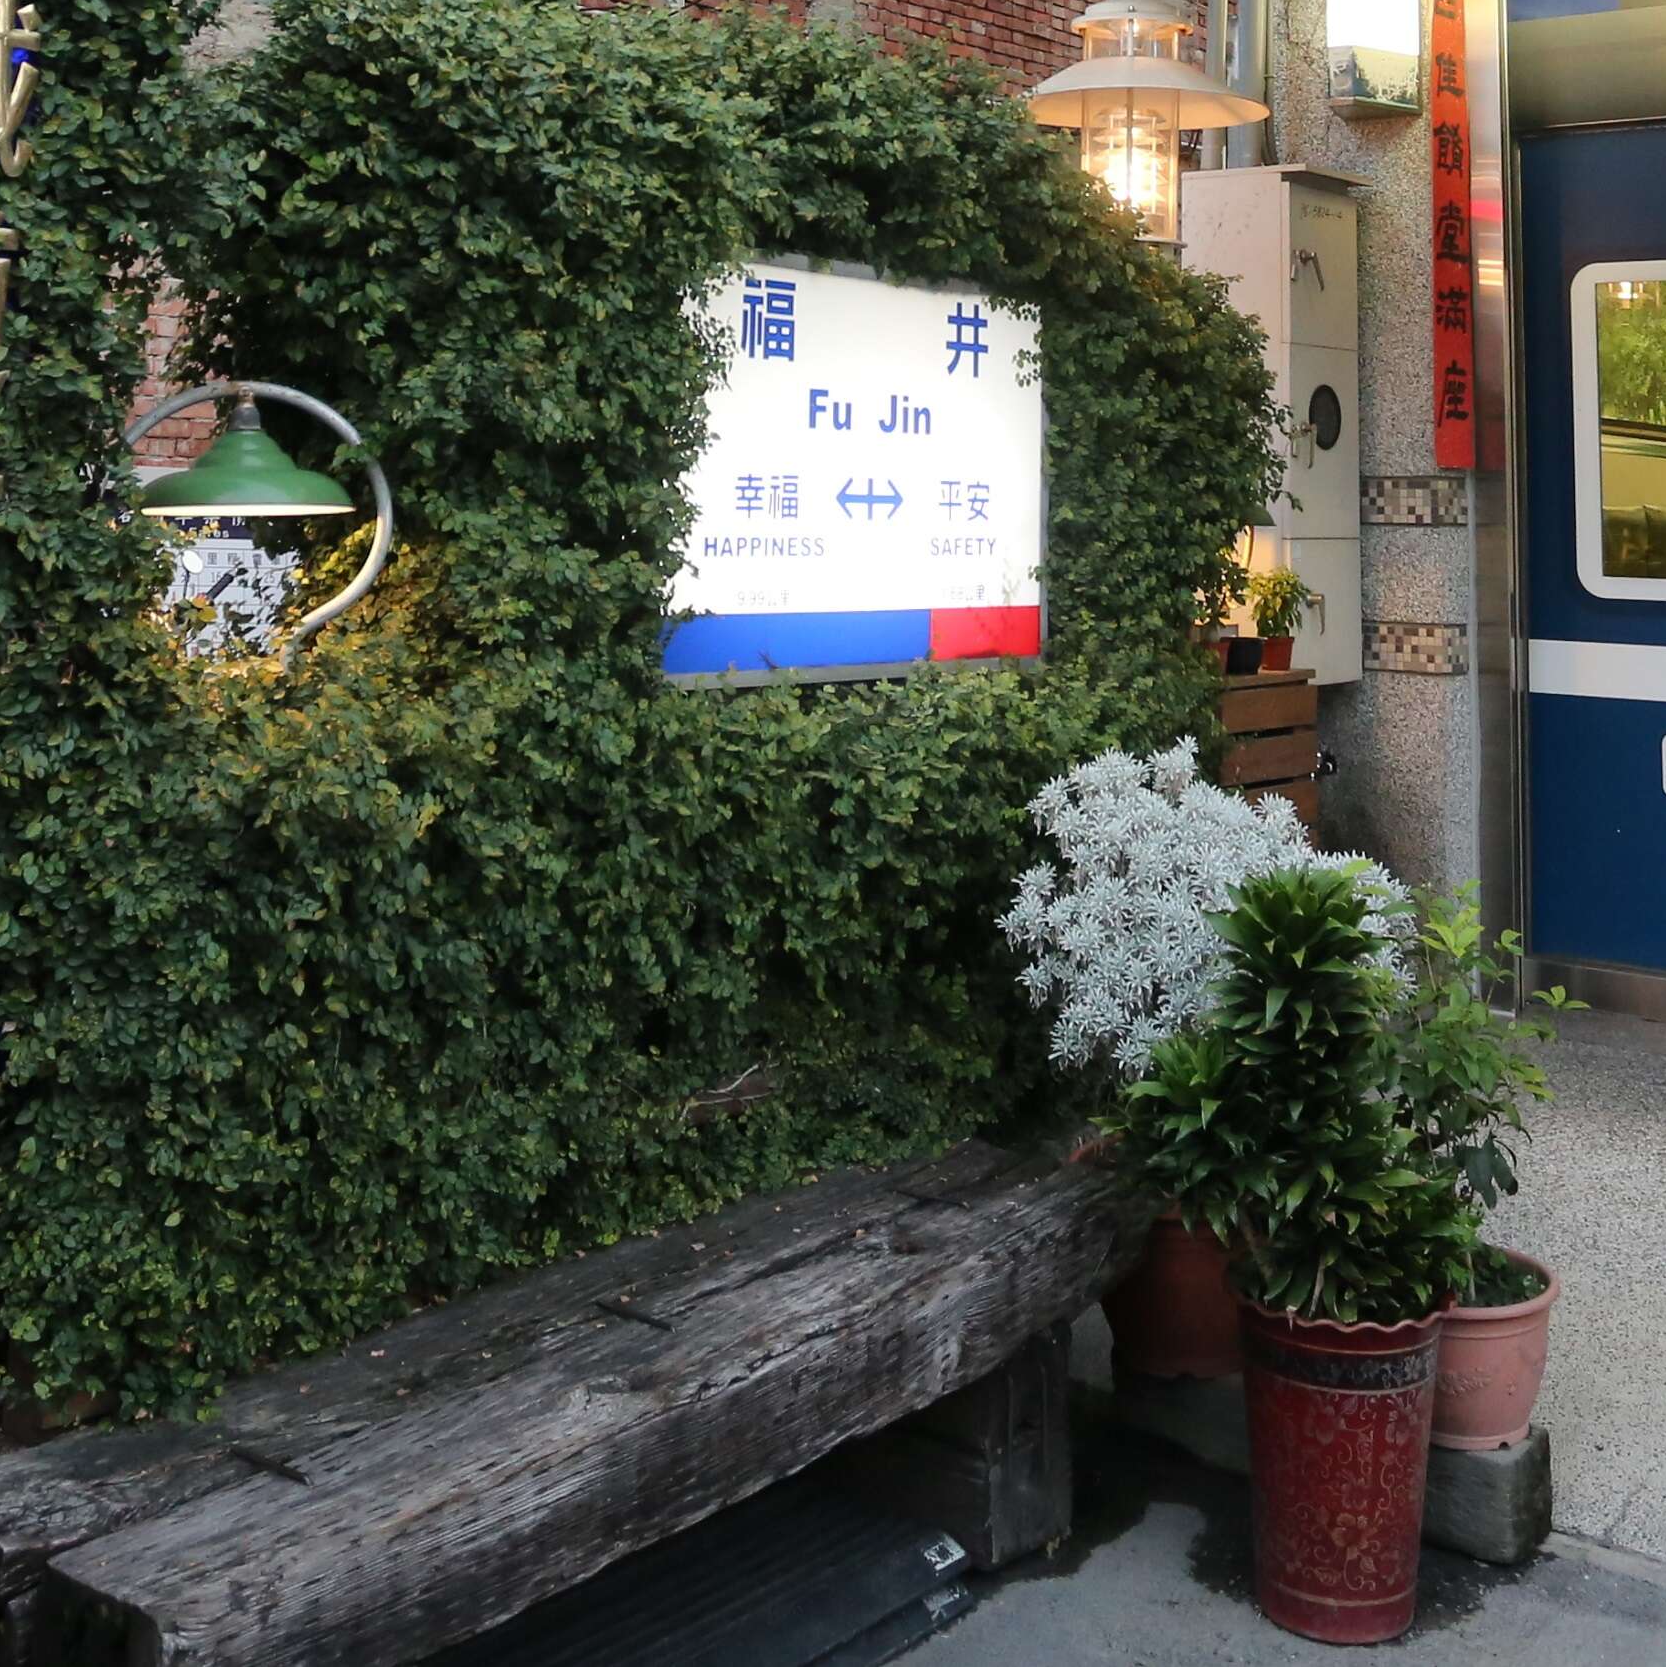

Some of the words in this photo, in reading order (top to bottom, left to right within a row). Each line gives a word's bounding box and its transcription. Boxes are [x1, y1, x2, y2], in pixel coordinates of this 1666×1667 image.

[808, 388, 852, 430] Fu
[878, 394, 932, 435] Jin
[735, 473, 799, 519] 幸福
[938, 480, 990, 521] 平安
[703, 536, 825, 558] HAPPINESS
[930, 537, 997, 557] SAFETY
